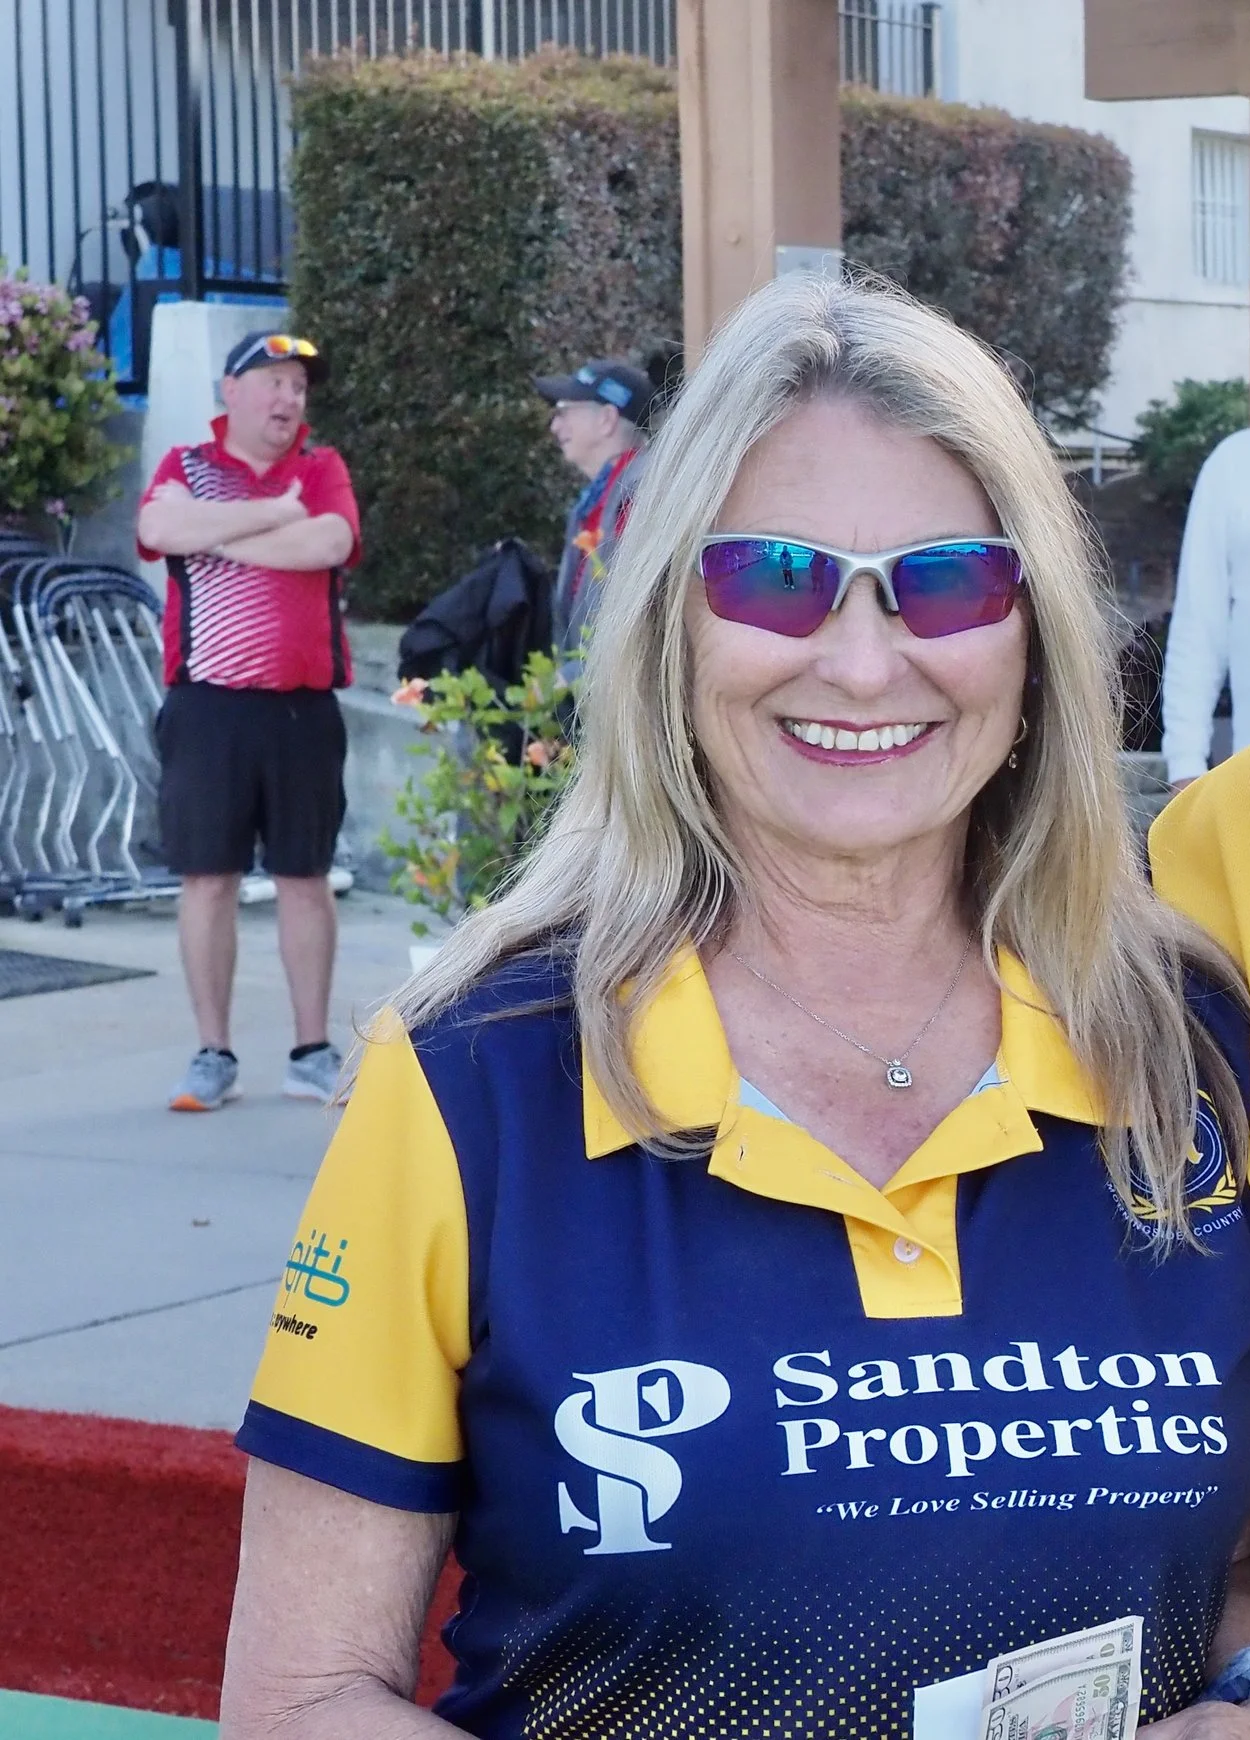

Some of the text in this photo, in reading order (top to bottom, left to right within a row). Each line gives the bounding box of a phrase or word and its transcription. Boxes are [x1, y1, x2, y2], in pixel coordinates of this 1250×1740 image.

[1193, 1205, 1245, 1237] COUNTRY
[773, 1341, 1223, 1408] Sandton
[776, 1400, 1229, 1478] Properties
[889, 1497, 962, 1517] Love
[970, 1489, 1078, 1511] Selling
